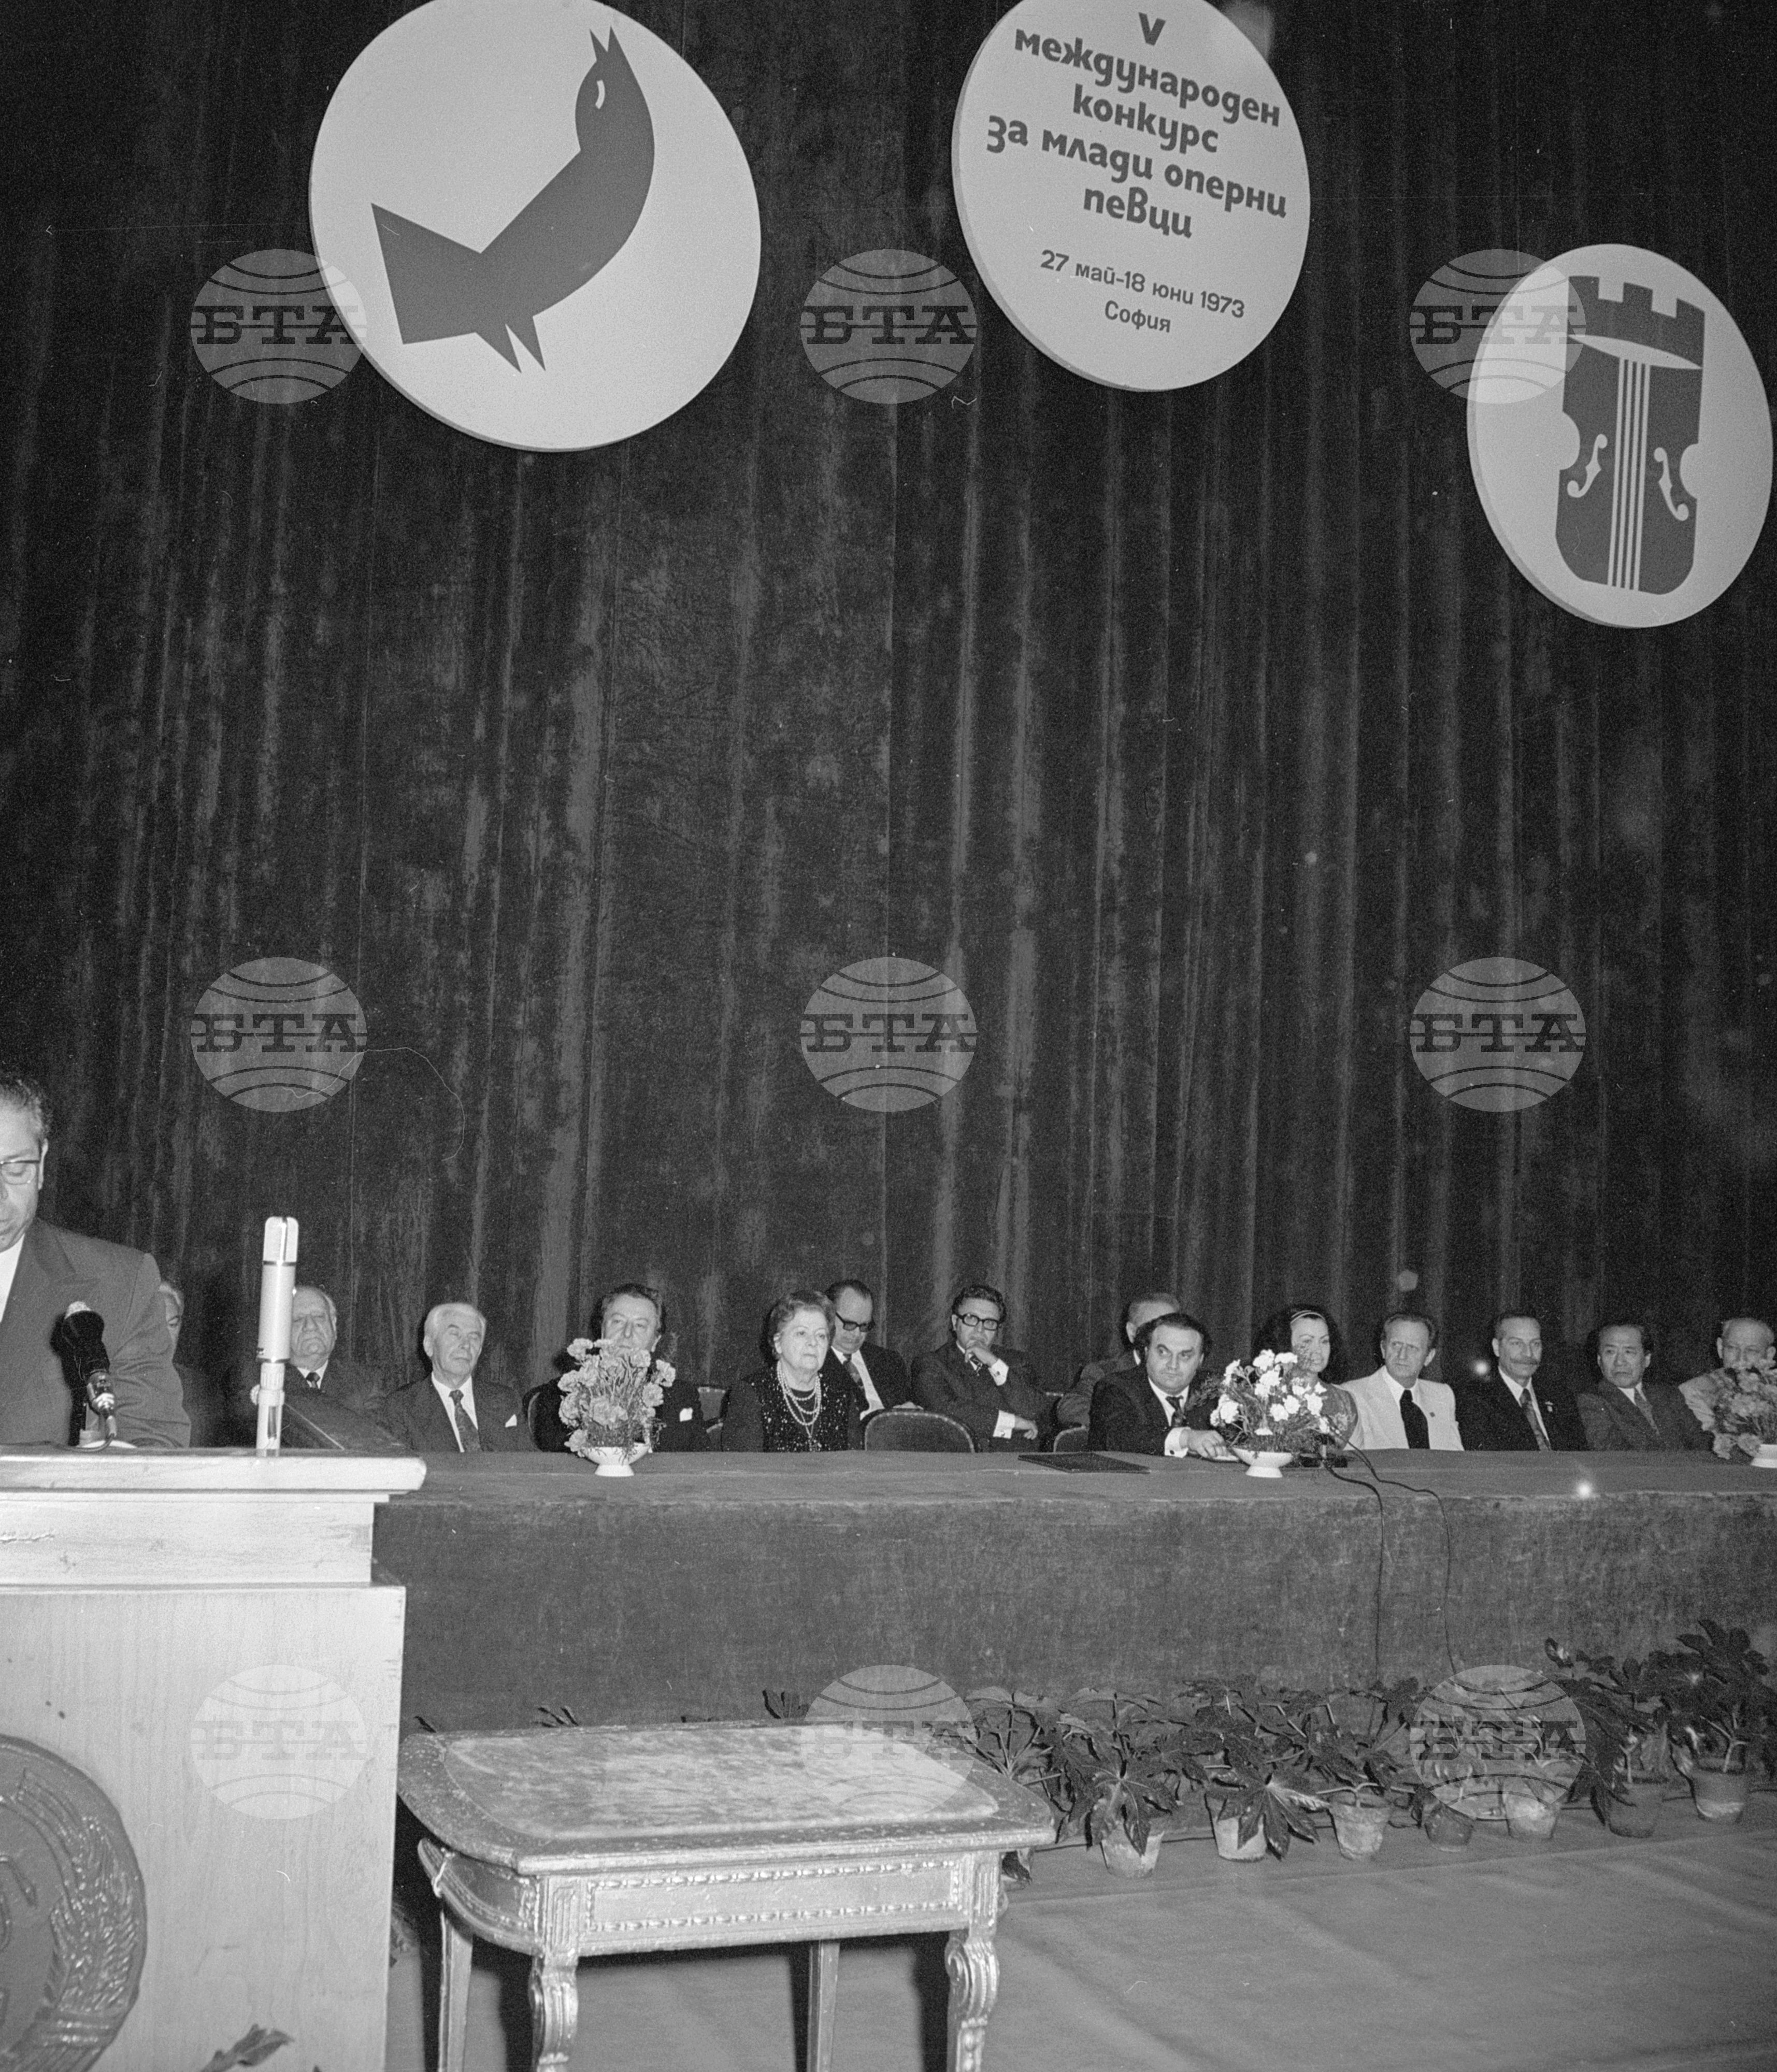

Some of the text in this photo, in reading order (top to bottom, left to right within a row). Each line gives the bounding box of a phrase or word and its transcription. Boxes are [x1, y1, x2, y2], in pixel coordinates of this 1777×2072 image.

[1138, 12, 1166, 46] V
[1014, 28, 1280, 127] международен
[1073, 83, 1219, 155] конкурс
[1042, 130, 1153, 183] млади
[1164, 164, 1287, 219] оперни
[1040, 249, 1245, 319] 27 май-18 юни 1973
[1104, 299, 1171, 333] София
